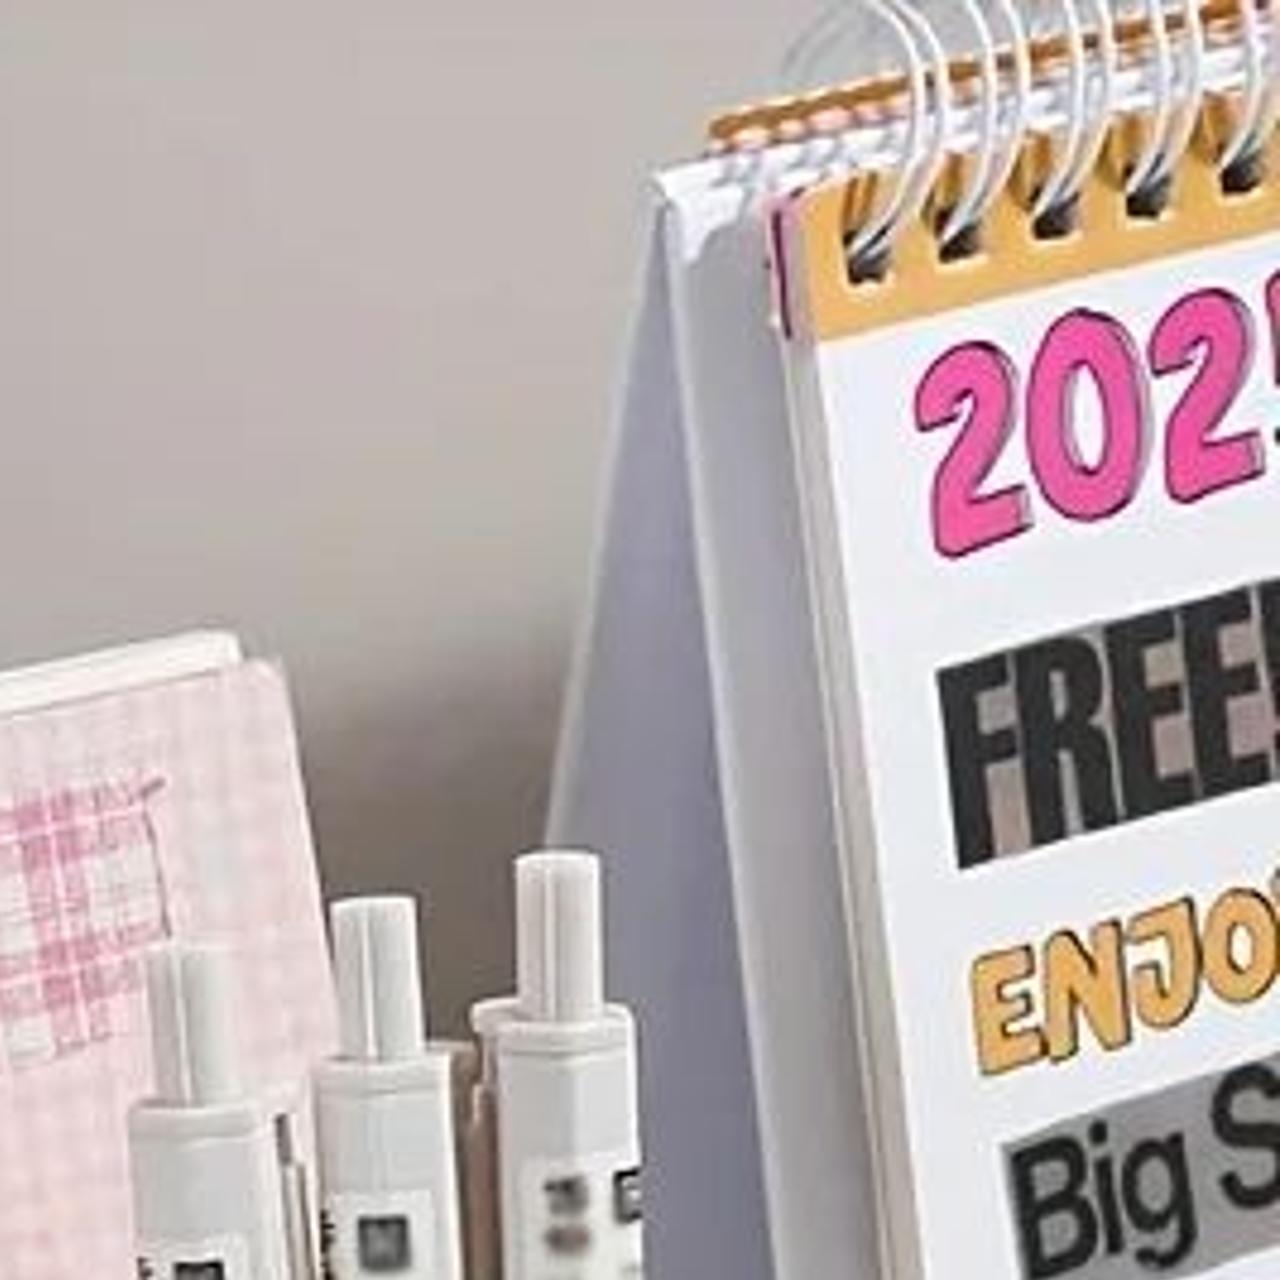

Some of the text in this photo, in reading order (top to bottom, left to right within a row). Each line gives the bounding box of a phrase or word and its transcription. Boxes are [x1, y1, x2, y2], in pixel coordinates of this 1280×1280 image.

[914, 280, 1280, 560] 202
[935, 577, 1280, 870] FREE
[971, 868, 1280, 1076] ENJO
